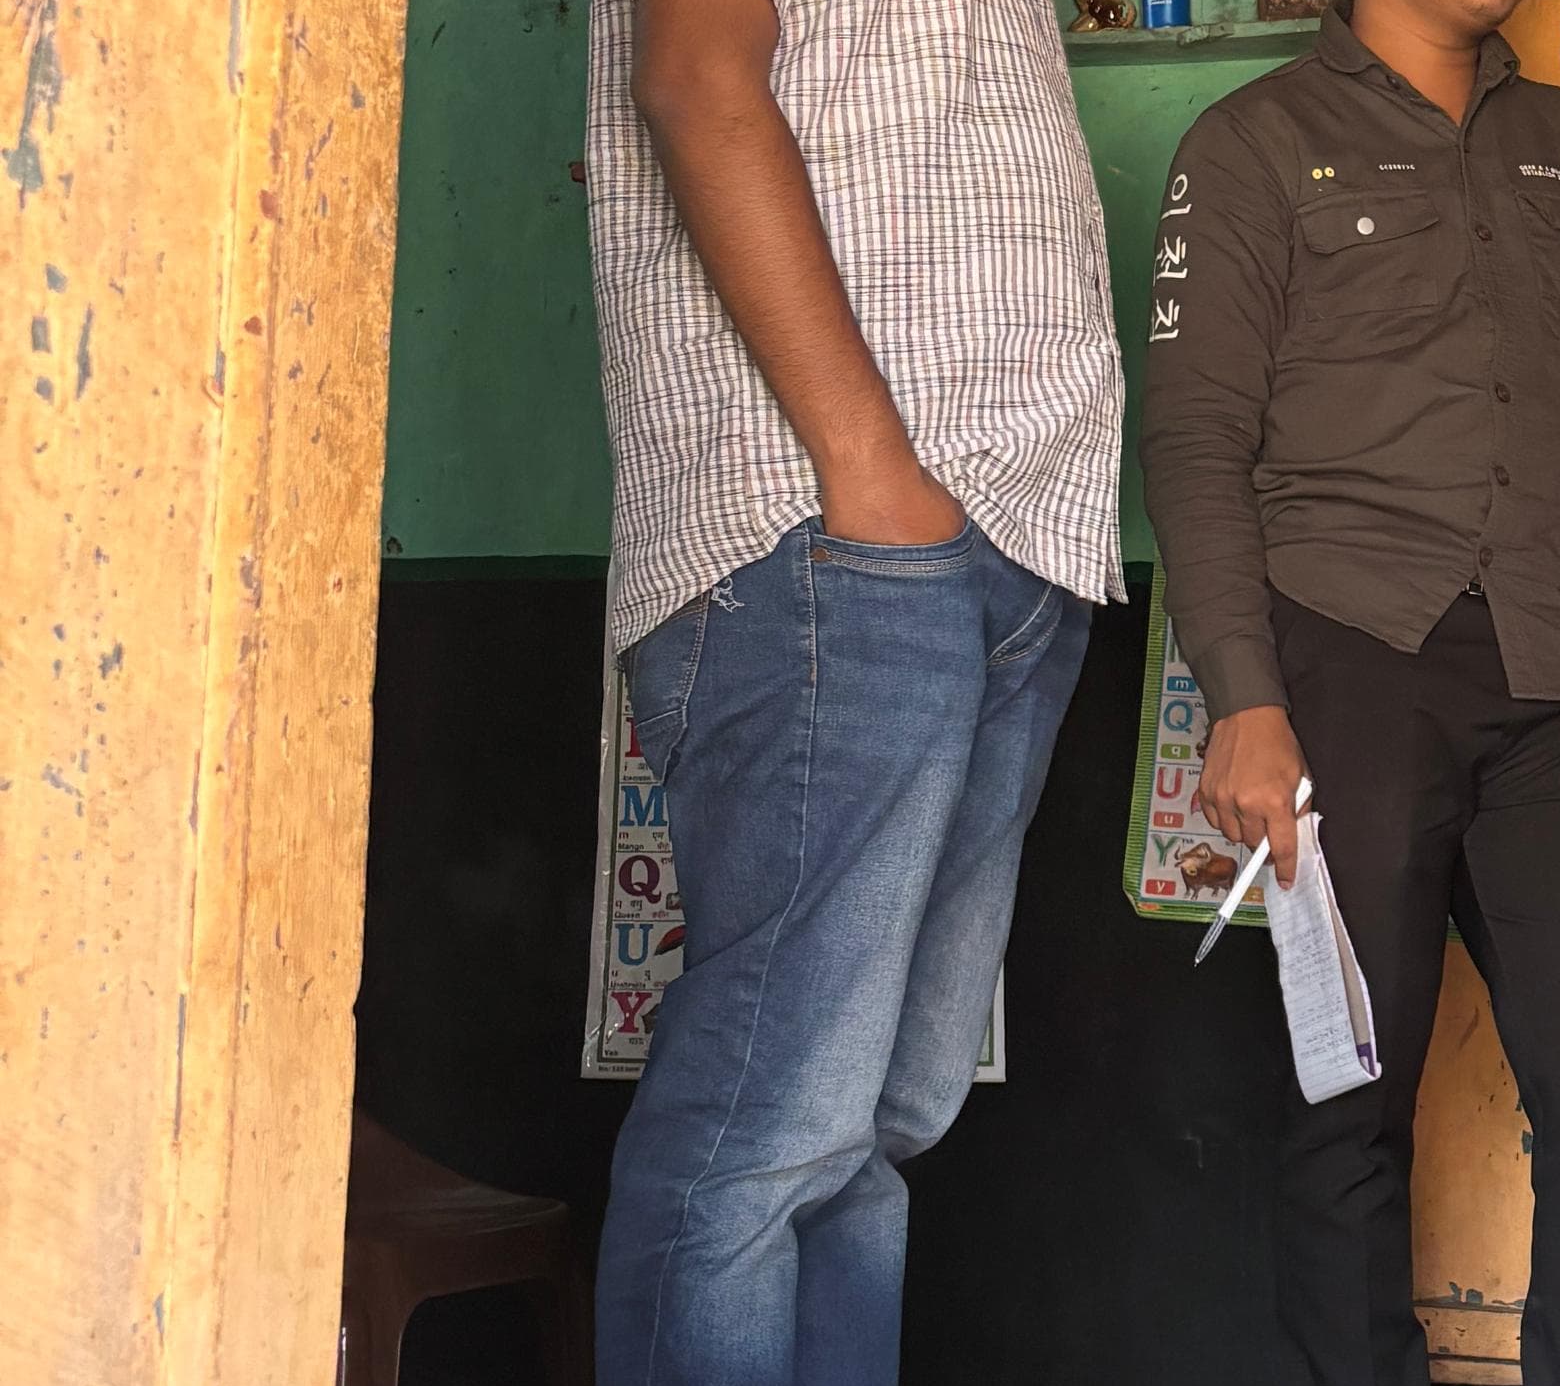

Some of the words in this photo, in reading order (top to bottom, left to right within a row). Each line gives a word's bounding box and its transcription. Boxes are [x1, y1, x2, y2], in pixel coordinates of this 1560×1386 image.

[1175, 679, 1190, 689] m
[1163, 699, 1193, 734] Q
[1171, 745, 1182, 757] q
[1156, 767, 1184, 799] U
[619, 785, 668, 827] M
[1163, 815, 1174, 825] u
[1151, 835, 1181, 867] Y
[618, 854, 662, 904] Q
[1155, 880, 1166, 893] y
[615, 923, 654, 966] U
[611, 992, 653, 1033] Y
